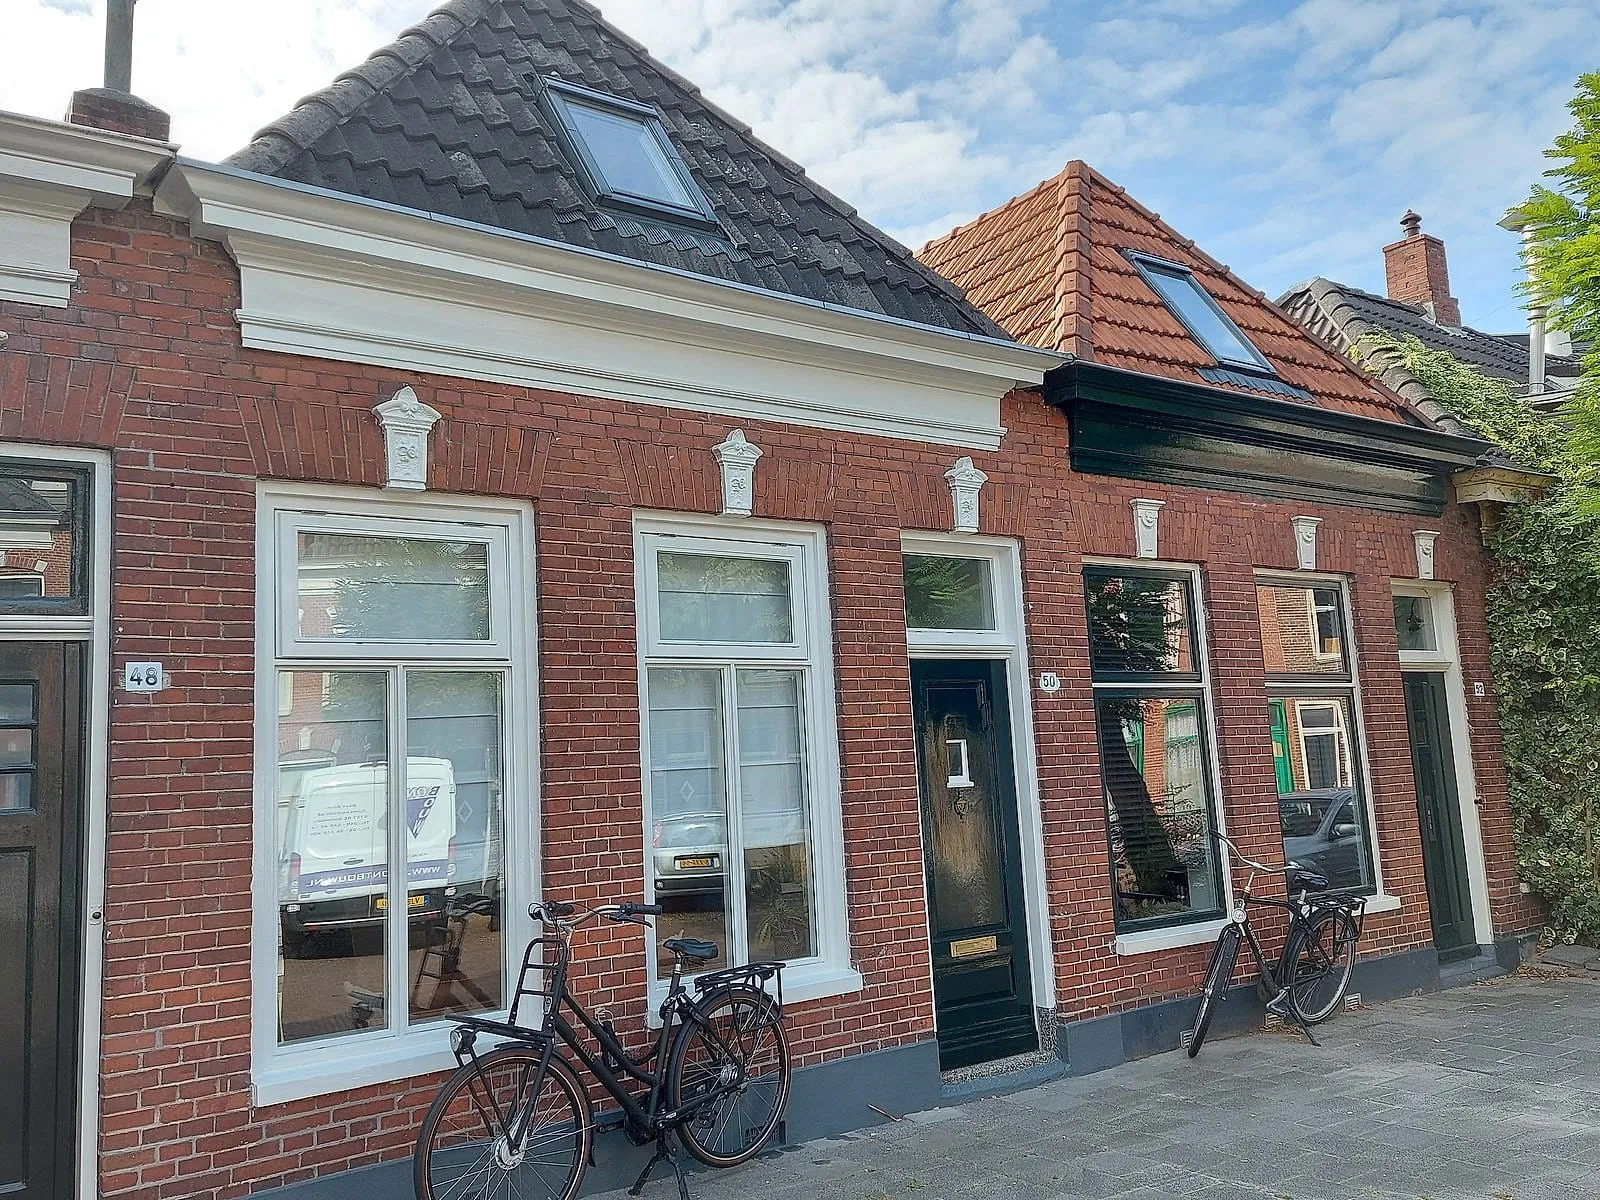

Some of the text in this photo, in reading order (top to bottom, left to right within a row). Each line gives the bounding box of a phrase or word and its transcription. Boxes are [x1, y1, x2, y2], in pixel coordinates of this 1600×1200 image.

[129, 666, 158, 686] 48
[1043, 675, 1056, 687] 50
[1476, 685, 1483, 694] 52
